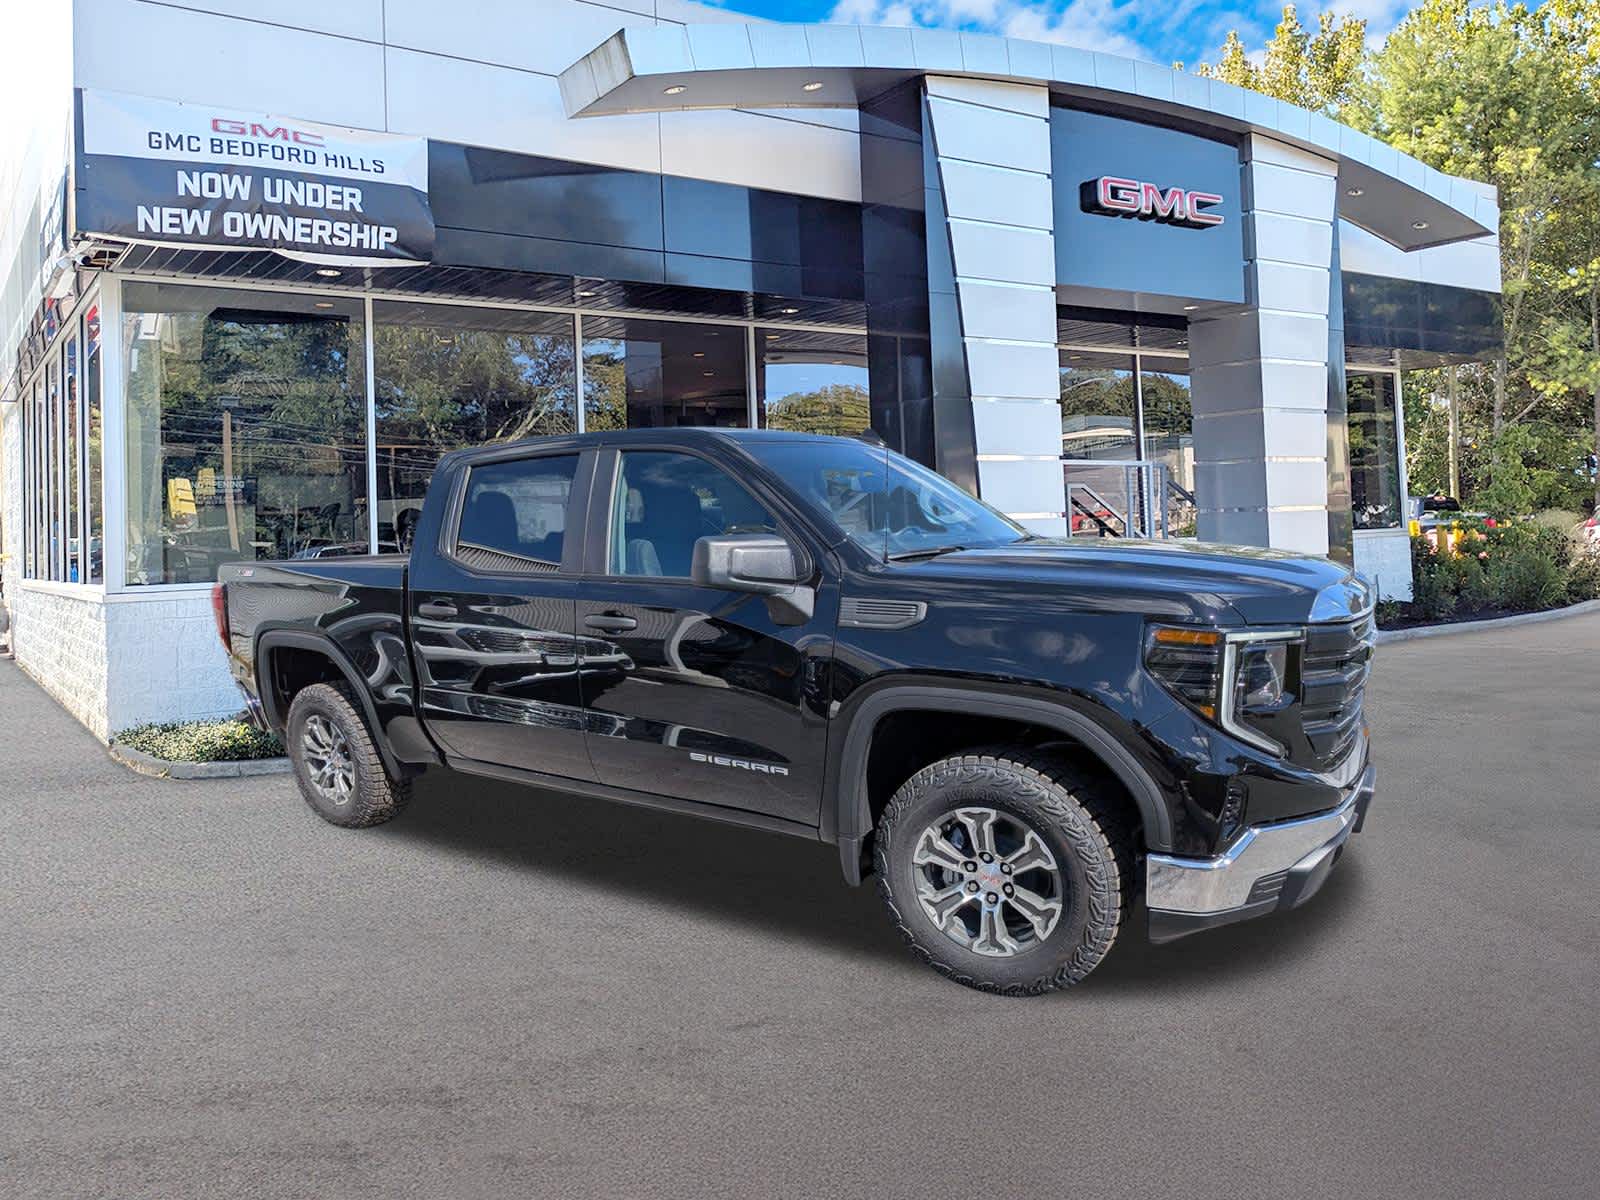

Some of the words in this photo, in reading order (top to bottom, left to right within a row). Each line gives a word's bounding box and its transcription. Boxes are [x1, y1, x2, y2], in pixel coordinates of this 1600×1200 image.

[148, 131, 201, 153] GMC
[210, 137, 317, 165] BEDFORD
[324, 152, 385, 174] HILLS
[212, 118, 326, 148] GMC
[177, 170, 252, 200] NOW
[263, 177, 363, 213] UNDER
[1099, 176, 1224, 224] GMC
[137, 205, 211, 236] NEW
[223, 211, 398, 250] OWNERSHIP
[689, 752, 789, 776] SIERRA
